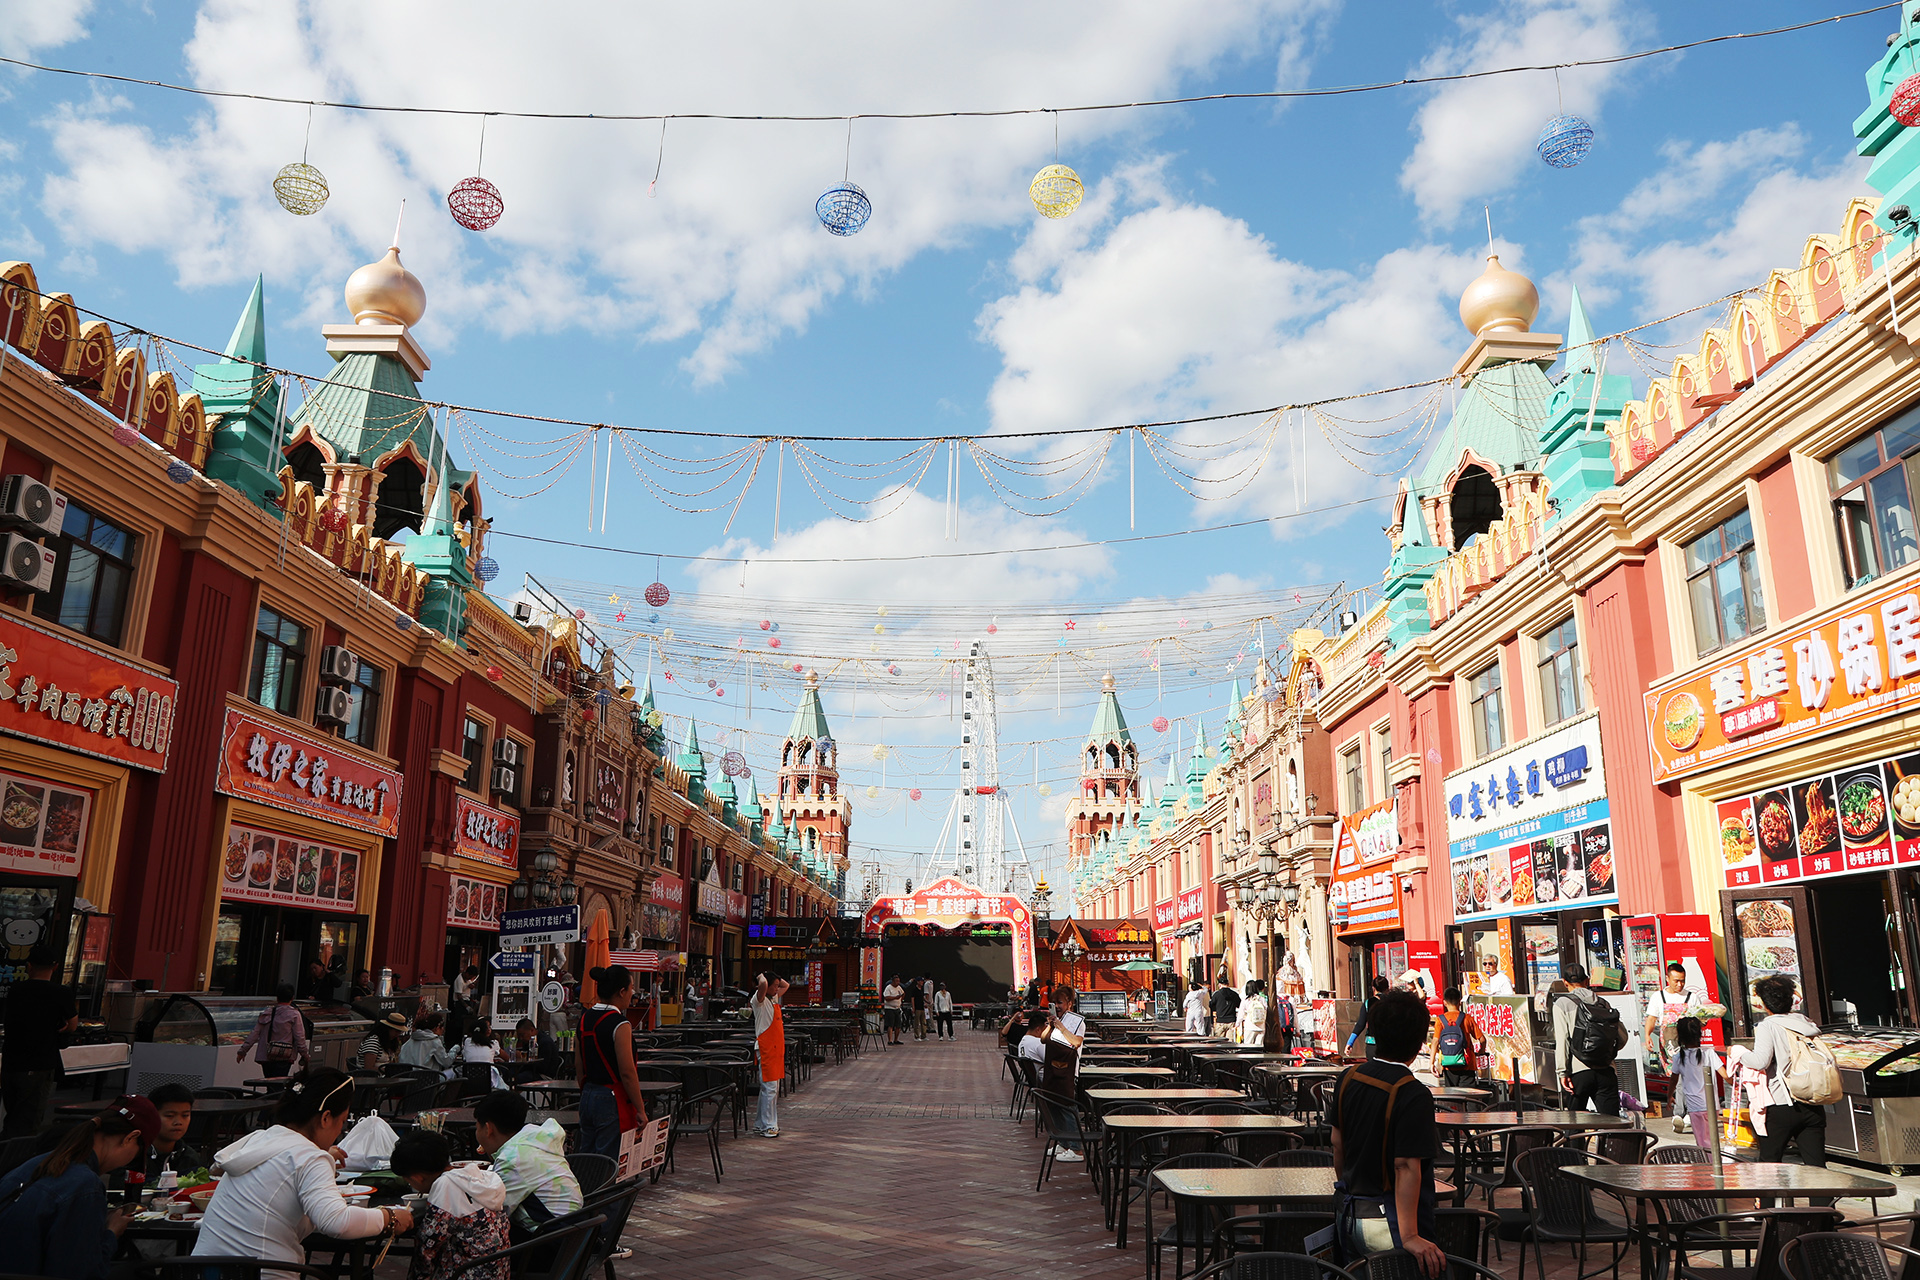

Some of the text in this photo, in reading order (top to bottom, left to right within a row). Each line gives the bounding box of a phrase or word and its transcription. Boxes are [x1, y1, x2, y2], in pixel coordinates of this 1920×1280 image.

[1723, 700, 1776, 734] 草原烧烤
[1814, 857, 1831, 872] 炒面
[1849, 848, 1890, 866] 砂锅手擀面
[1735, 870, 1750, 883] 汉堡
[1773, 864, 1789, 878] 砂锅
[752, 898, 760, 918] 清真
[505, 913, 572, 930] 想你的风吹到了套娃广场
[748, 925, 777, 937] 雪糕
[1087, 952, 1114, 961] 锅巴土豆
[814, 962, 822, 991] 啤酒免费
